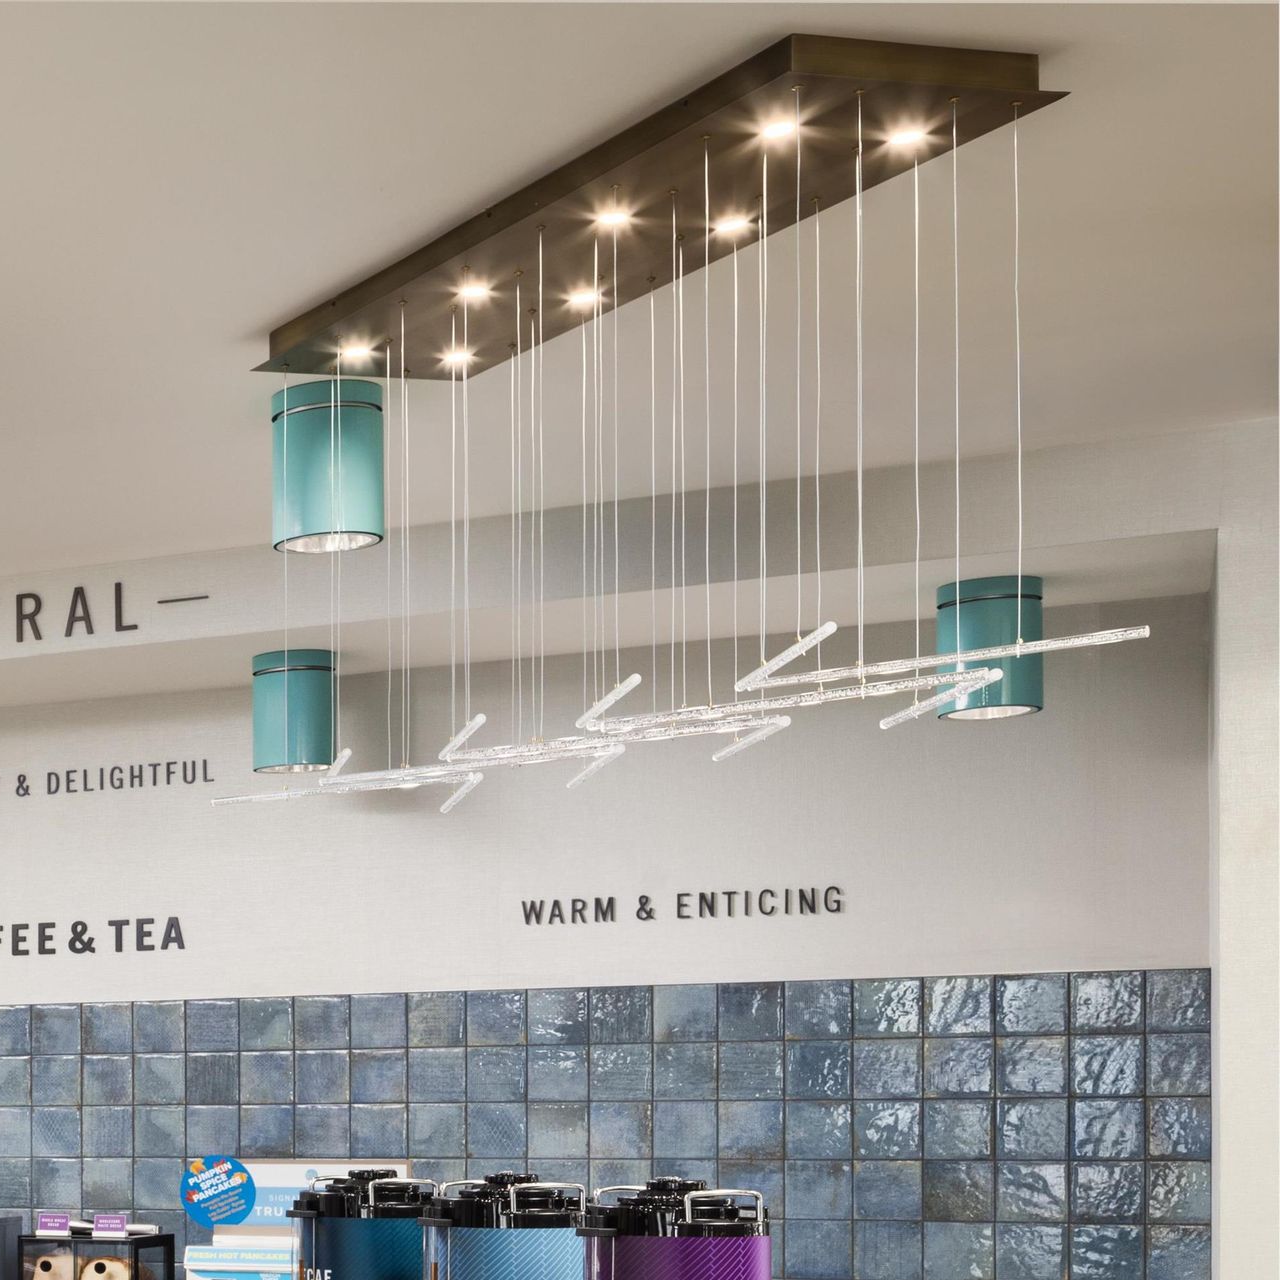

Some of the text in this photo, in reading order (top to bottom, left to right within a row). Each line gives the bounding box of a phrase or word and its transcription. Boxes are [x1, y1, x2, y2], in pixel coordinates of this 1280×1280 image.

[15, 774, 31, 797] &
[47, 759, 215, 795] DELIGHTFUL
[521, 886, 843, 925] WARM & ENTICING
[68, 920, 96, 955] &
[107, 917, 186, 953] TEA
[187, 1161, 233, 1187] PUMPKIN
[192, 1176, 242, 1203] PANCAKES
[200, 1174, 228, 1190] SPICE
